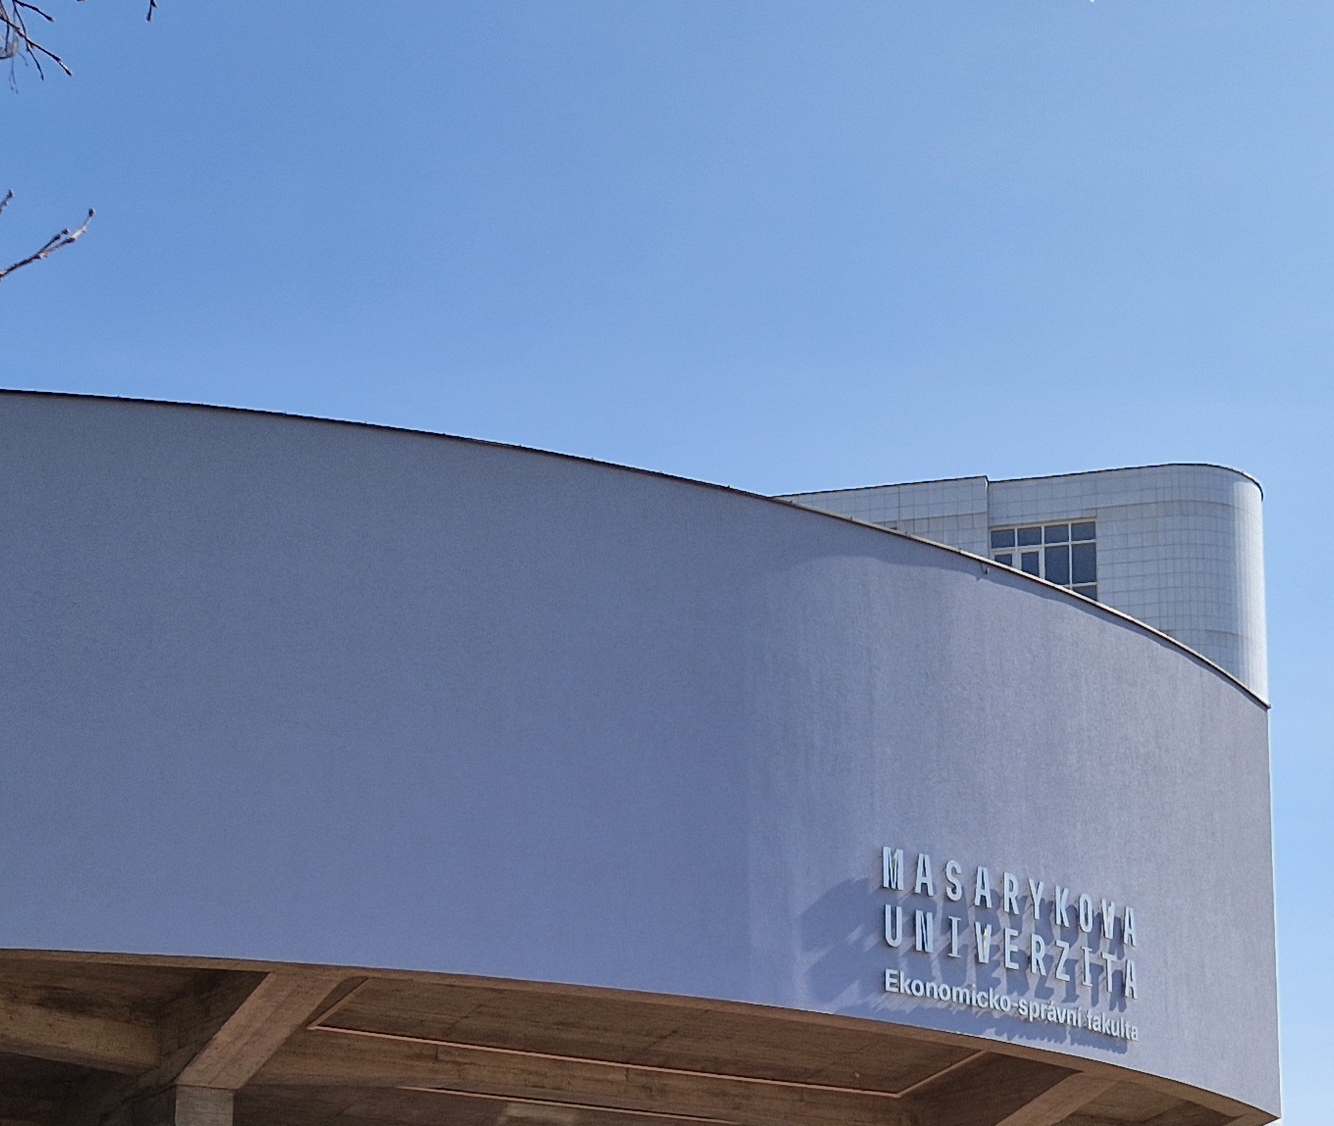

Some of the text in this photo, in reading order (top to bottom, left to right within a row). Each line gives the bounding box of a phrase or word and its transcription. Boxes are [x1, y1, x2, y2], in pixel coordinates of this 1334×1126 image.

[881, 846, 1137, 947] MASARYKOVA
[883, 904, 1137, 999] UNIVERZITA
[884, 968, 1139, 1042] Ekonomicko-správní fakulta
